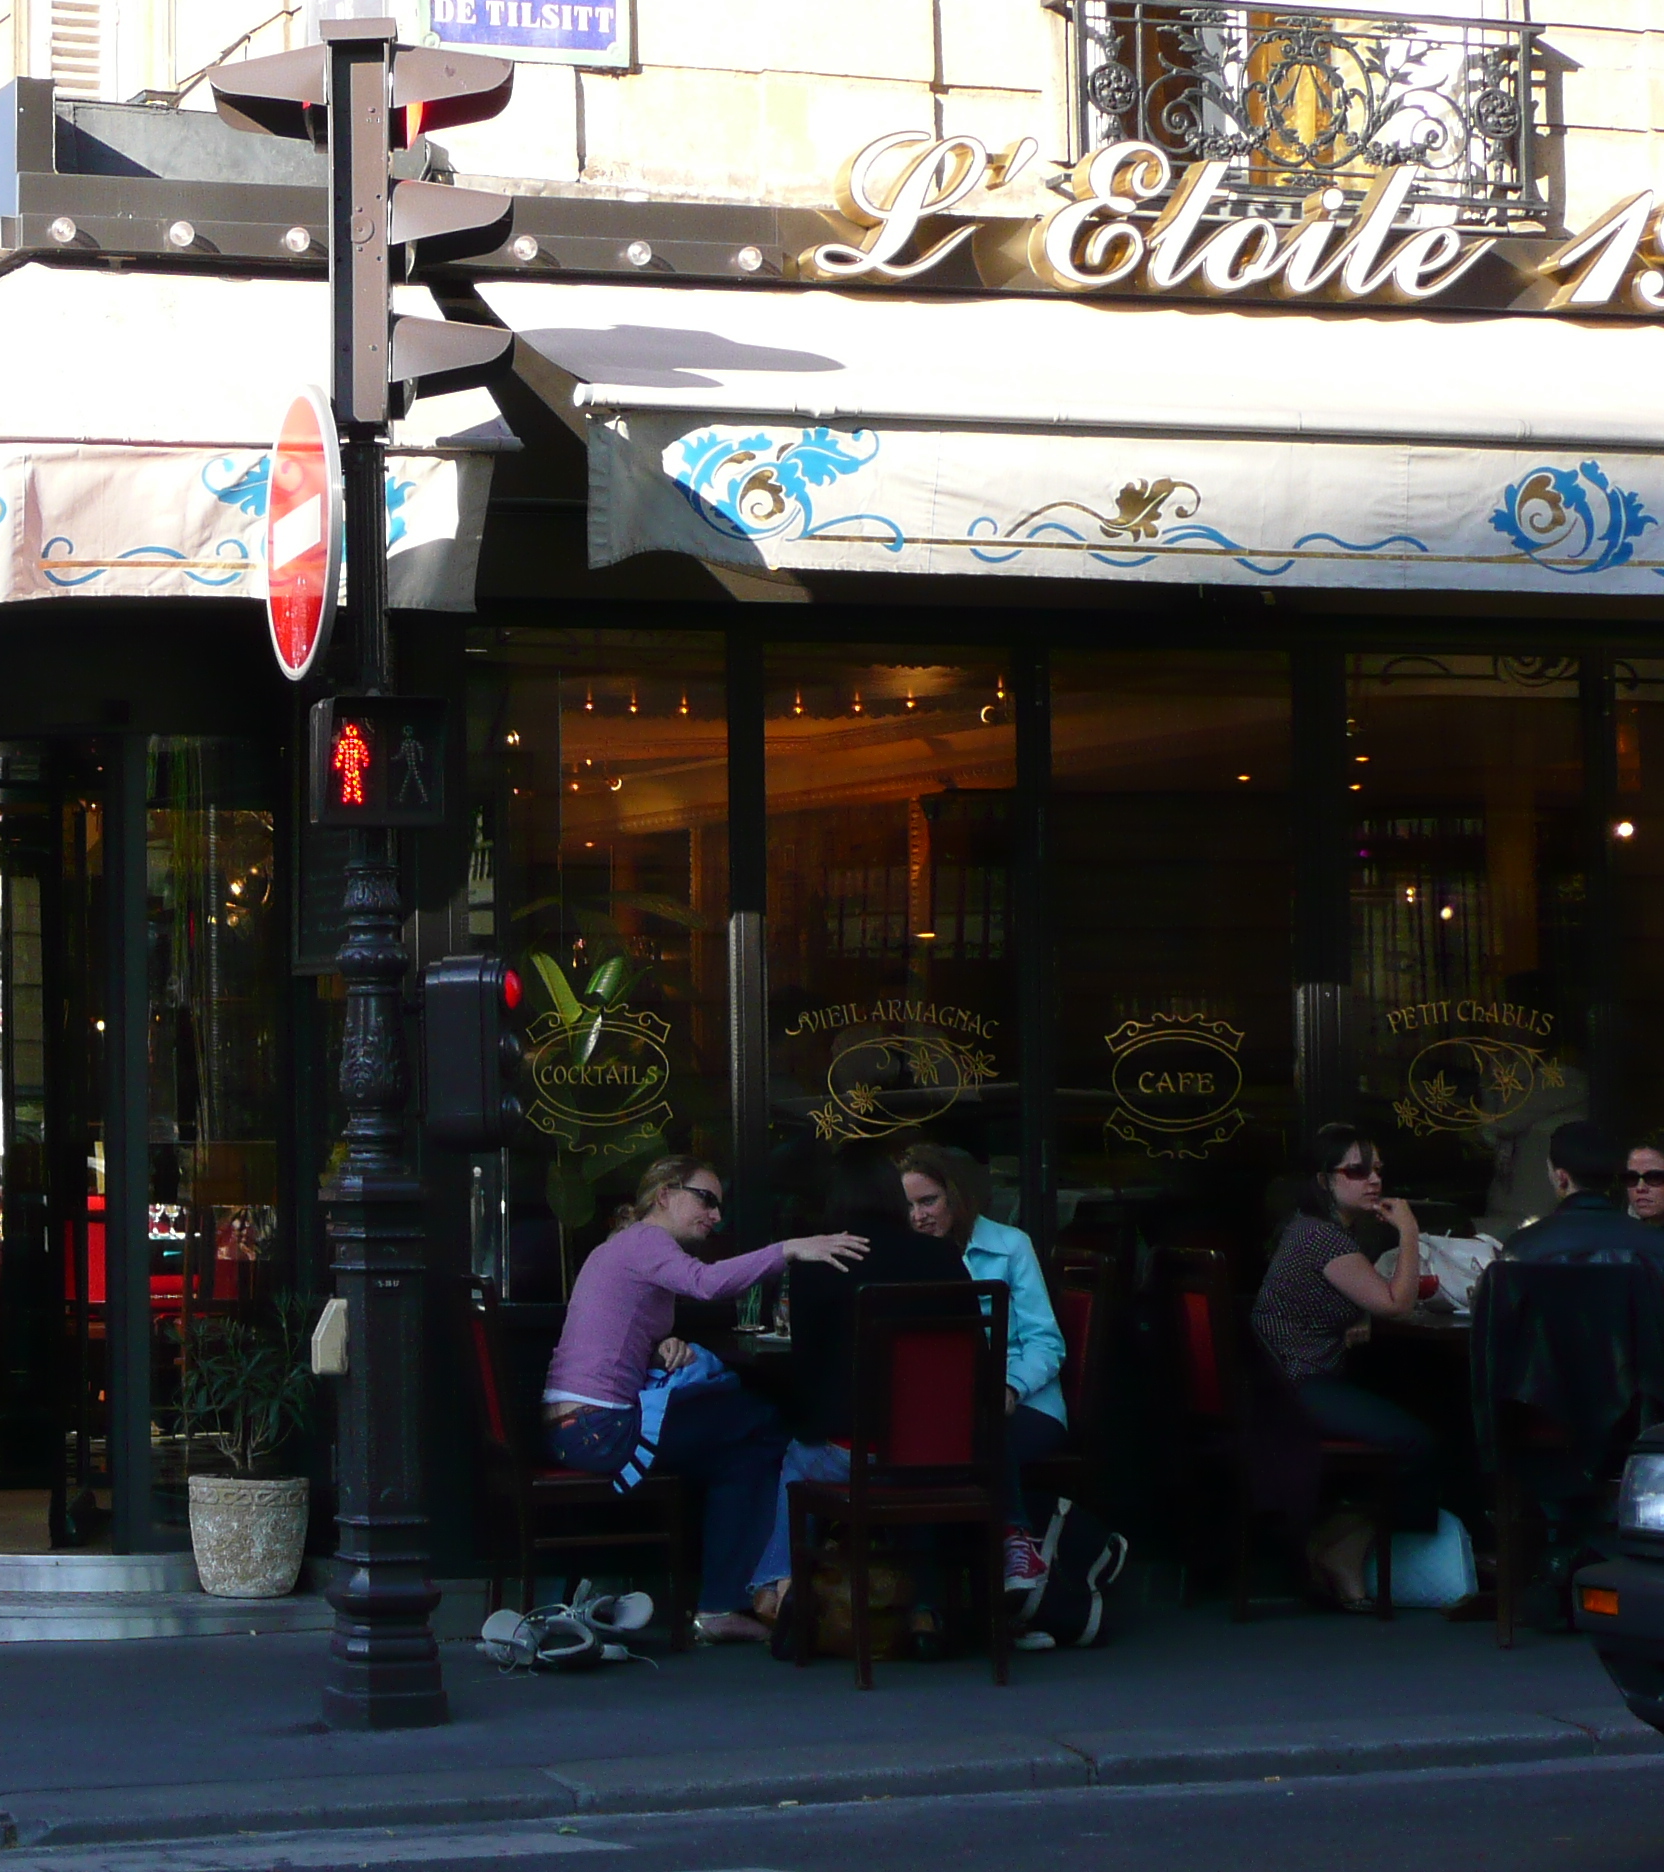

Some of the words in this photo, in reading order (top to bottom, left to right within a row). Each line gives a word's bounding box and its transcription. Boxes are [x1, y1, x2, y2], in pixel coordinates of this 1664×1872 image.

[434, 0, 477, 24] DE
[486, 0, 614, 33] TILSITT
[813, 130, 1497, 298] L'Etoile
[1557, 187, 1664, 307] 1
[785, 1003, 867, 1035] VIEIL
[871, 999, 1000, 1039] ARMAGNAC
[1386, 1001, 1451, 1035] PETIT
[540, 1065, 658, 1086] COCKTAILS
[1138, 1071, 1215, 1094] CAFE
